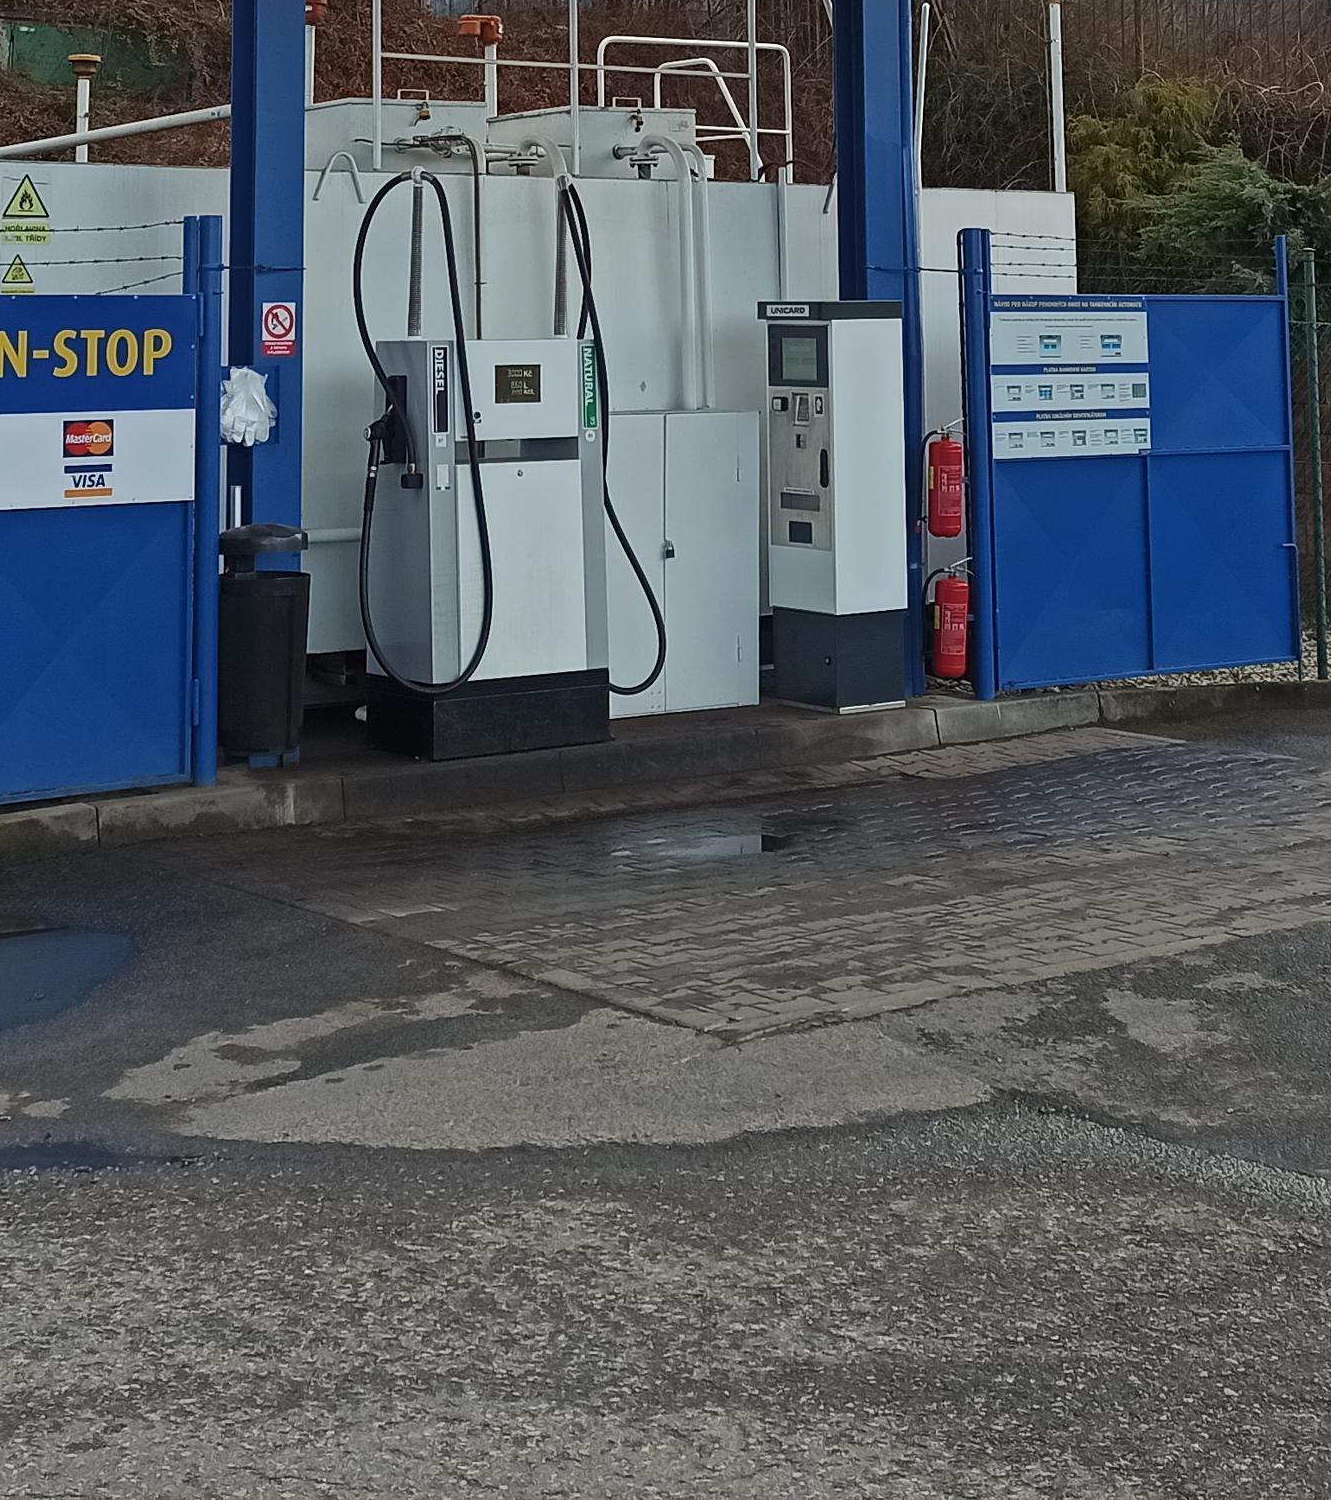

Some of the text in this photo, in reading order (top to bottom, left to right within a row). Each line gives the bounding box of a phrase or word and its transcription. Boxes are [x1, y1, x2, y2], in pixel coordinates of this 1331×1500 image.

[434, 348, 445, 395] DIESEL
[583, 347, 594, 407] NATURAL
[64, 432, 112, 445] MasterCard
[72, 474, 106, 488] VISA
